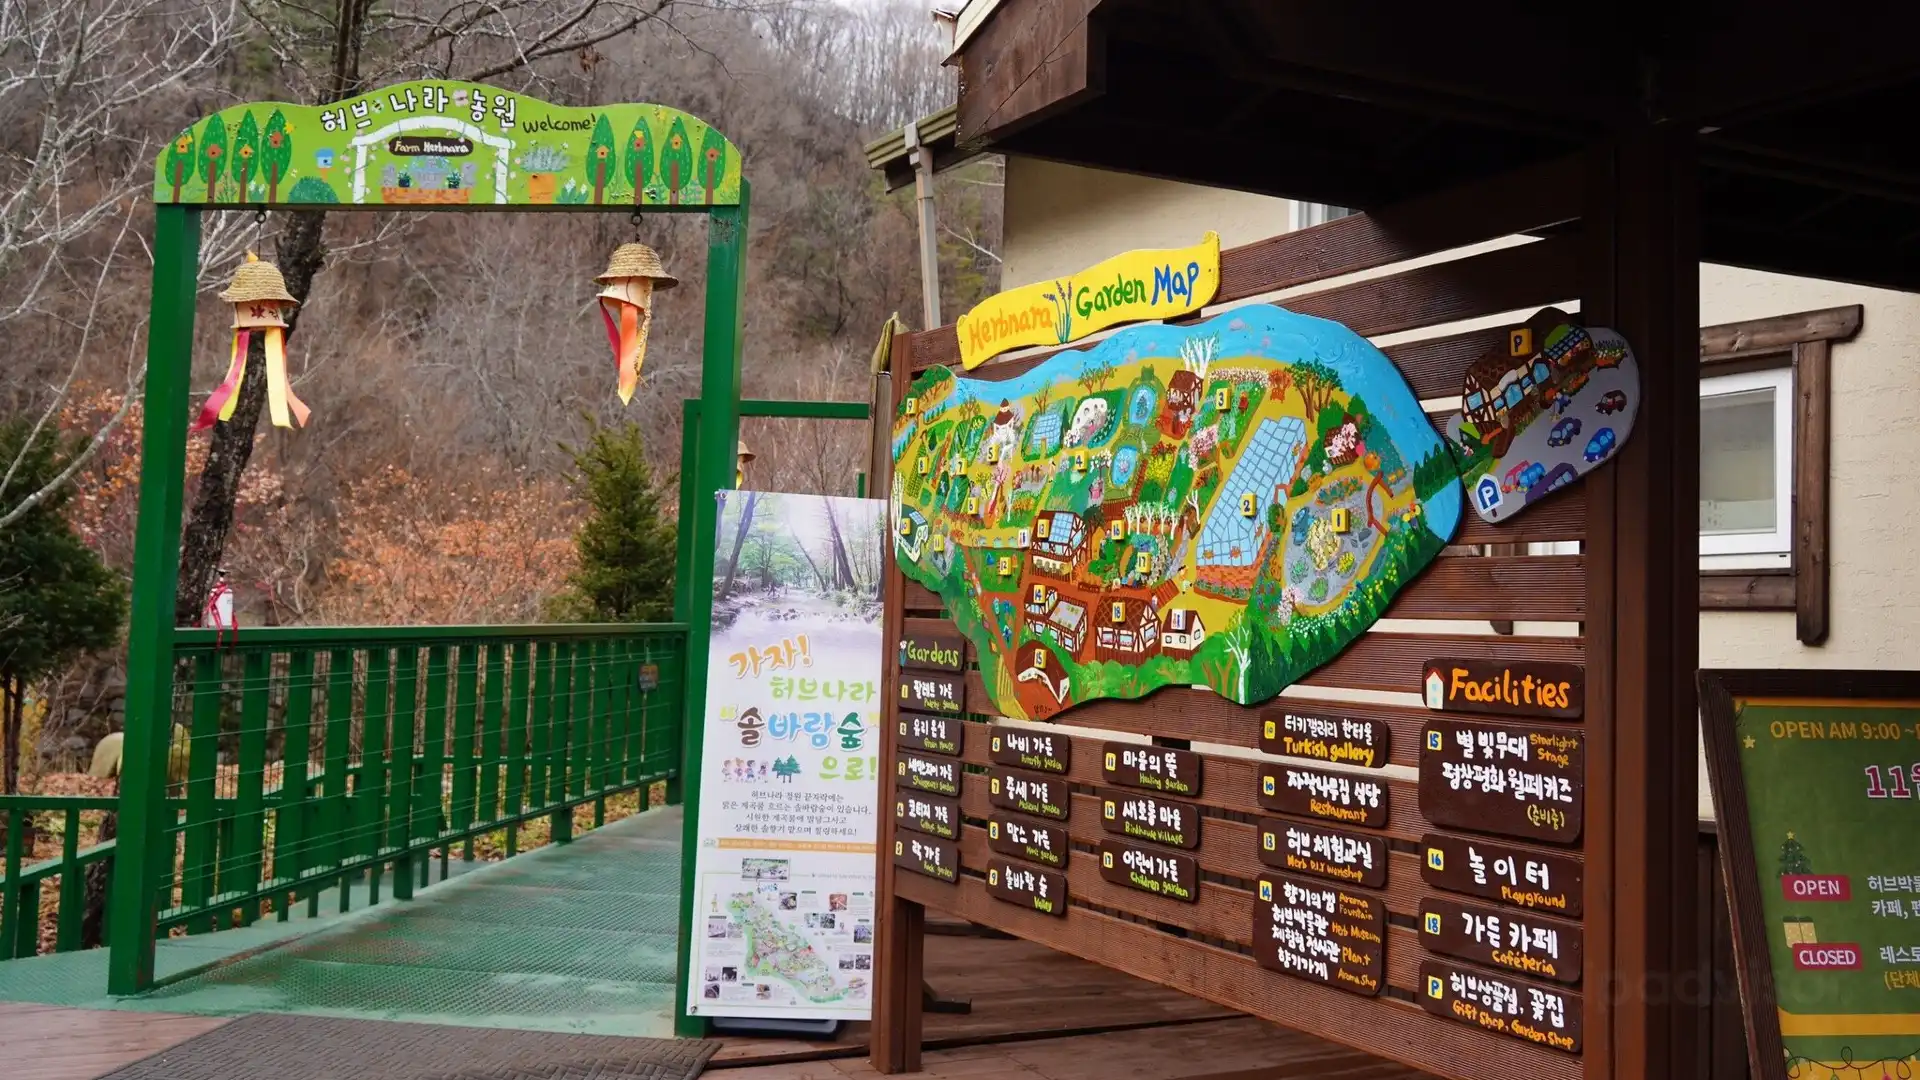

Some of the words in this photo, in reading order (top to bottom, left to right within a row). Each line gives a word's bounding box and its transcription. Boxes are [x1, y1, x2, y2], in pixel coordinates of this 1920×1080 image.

[394, 142, 421, 153] Farm
[423, 141, 470, 153] Herbnara
[968, 305, 1053, 356] Herbnara
[1076, 273, 1147, 320] Garden
[1513, 335, 1523, 353] P
[1218, 392, 1225, 407] 3
[1075, 455, 1082, 467] 4
[1243, 500, 1250, 513] 2
[1482, 485, 1494, 507] P
[1113, 523, 1120, 537] 16
[1138, 556, 1146, 568] 17
[1114, 606, 1121, 620] 18
[728, 633, 813, 679] 가자!
[907, 640, 959, 667] Gardens
[1035, 651, 1043, 665] 15
[769, 676, 876, 703] 허브나라
[1449, 667, 1571, 709] Facilities
[913, 719, 929, 736] 유리
[1284, 714, 1339, 739] 터키갤러리
[1770, 720, 1824, 739] OPEN
[1829, 721, 1857, 740] AM
[1861, 722, 1900, 740] 9:00
[1007, 733, 1030, 754] 나비
[1033, 737, 1053, 757] 가든
[1284, 737, 1328, 759] Turkish
[1429, 732, 1439, 749] 15
[1529, 732, 1579, 752] Starlight
[819, 755, 877, 781] 으로!
[1123, 750, 1161, 774] 마음의
[1537, 748, 1570, 769] Stage
[1164, 778, 1189, 792] garden
[1265, 780, 1274, 792] 10
[1442, 761, 1507, 794] 평창평화
[1006, 775, 1028, 802] 중세
[1030, 782, 1049, 804] 가든
[1286, 770, 1350, 805] 자작나무집
[1353, 781, 1382, 808] 식당
[1107, 804, 1115, 818] 12
[1159, 806, 1182, 832] 마을
[1310, 798, 1368, 823] Restaurant
[1527, 803, 1565, 831] (준비중)
[1032, 829, 1051, 851] 가든
[1157, 829, 1184, 845] Village
[1265, 835, 1274, 847] 13
[924, 845, 940, 865] 가든
[1286, 828, 1311, 858] 허브
[1313, 834, 1373, 870] 체험교실
[1156, 857, 1179, 883] 가든
[1430, 854, 1442, 867] 16
[1005, 865, 1035, 892] 솔바람
[1130, 871, 1160, 892] Children
[1163, 880, 1189, 898] garden
[1793, 880, 1840, 896] OPEN
[1262, 885, 1271, 900] 14
[1283, 881, 1322, 909] 향기의
[1501, 885, 1566, 909] Playground
[1271, 903, 1329, 937] 허브박물관
[1339, 904, 1373, 921] Fountain
[1872, 899, 1908, 919] 카페,
[1427, 917, 1439, 934] 18
[1461, 912, 1500, 949] 가든
[1508, 922, 1559, 960] 카페
[1278, 946, 1329, 981] 향기가게
[1799, 950, 1856, 966] CLOSED
[1431, 980, 1440, 995] P
[1528, 988, 1565, 1028] 꽃집
[1452, 999, 1477, 1022] Gift
[1511, 1019, 1547, 1043] Garden
[1548, 1031, 1575, 1050] Shop
